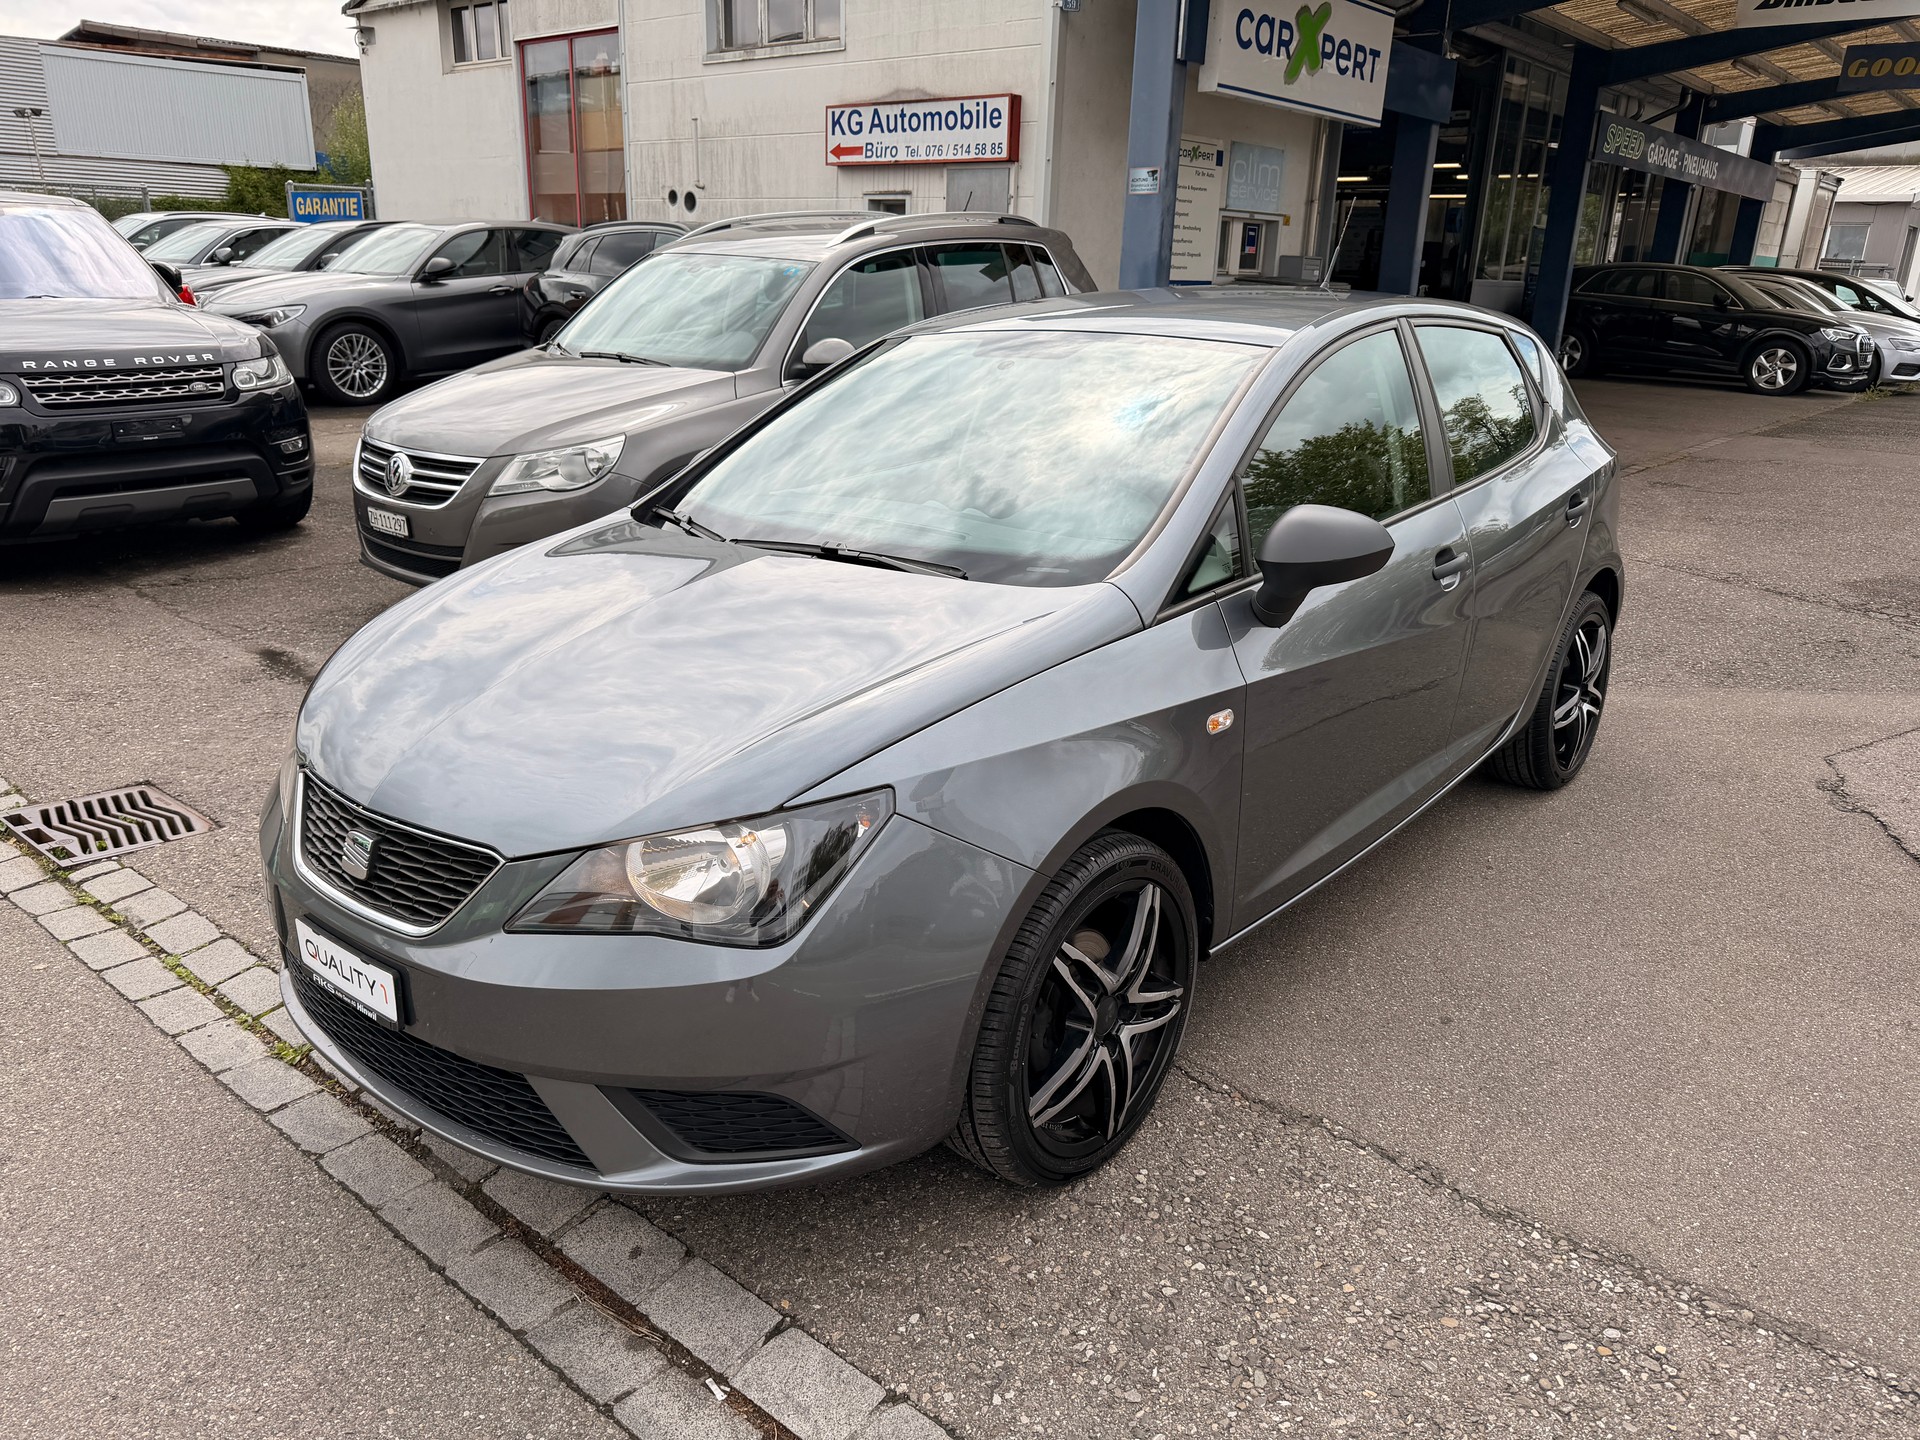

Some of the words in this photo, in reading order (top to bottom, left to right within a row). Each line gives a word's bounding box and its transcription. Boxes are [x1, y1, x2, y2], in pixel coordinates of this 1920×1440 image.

[1848, 57, 1920, 77] GOO
[831, 109, 863, 136] KG
[868, 101, 1002, 134] Automobile
[865, 142, 898, 159] Büro
[905, 145, 921, 158] Tel.
[925, 144, 943, 157] 076
[952, 143, 971, 156] 514
[974, 143, 987, 156] 58
[990, 142, 1003, 155] 85
[1603, 123, 1645, 160] SPEED
[1647, 143, 1679, 170] GARAGE
[1682, 153, 1719, 180] PNEUHAUS
[296, 197, 358, 216] GARANTIE
[22, 359, 117, 369] RANGE
[133, 353, 215, 365] ROVER
[357, 1002, 377, 1021] Hinwil
